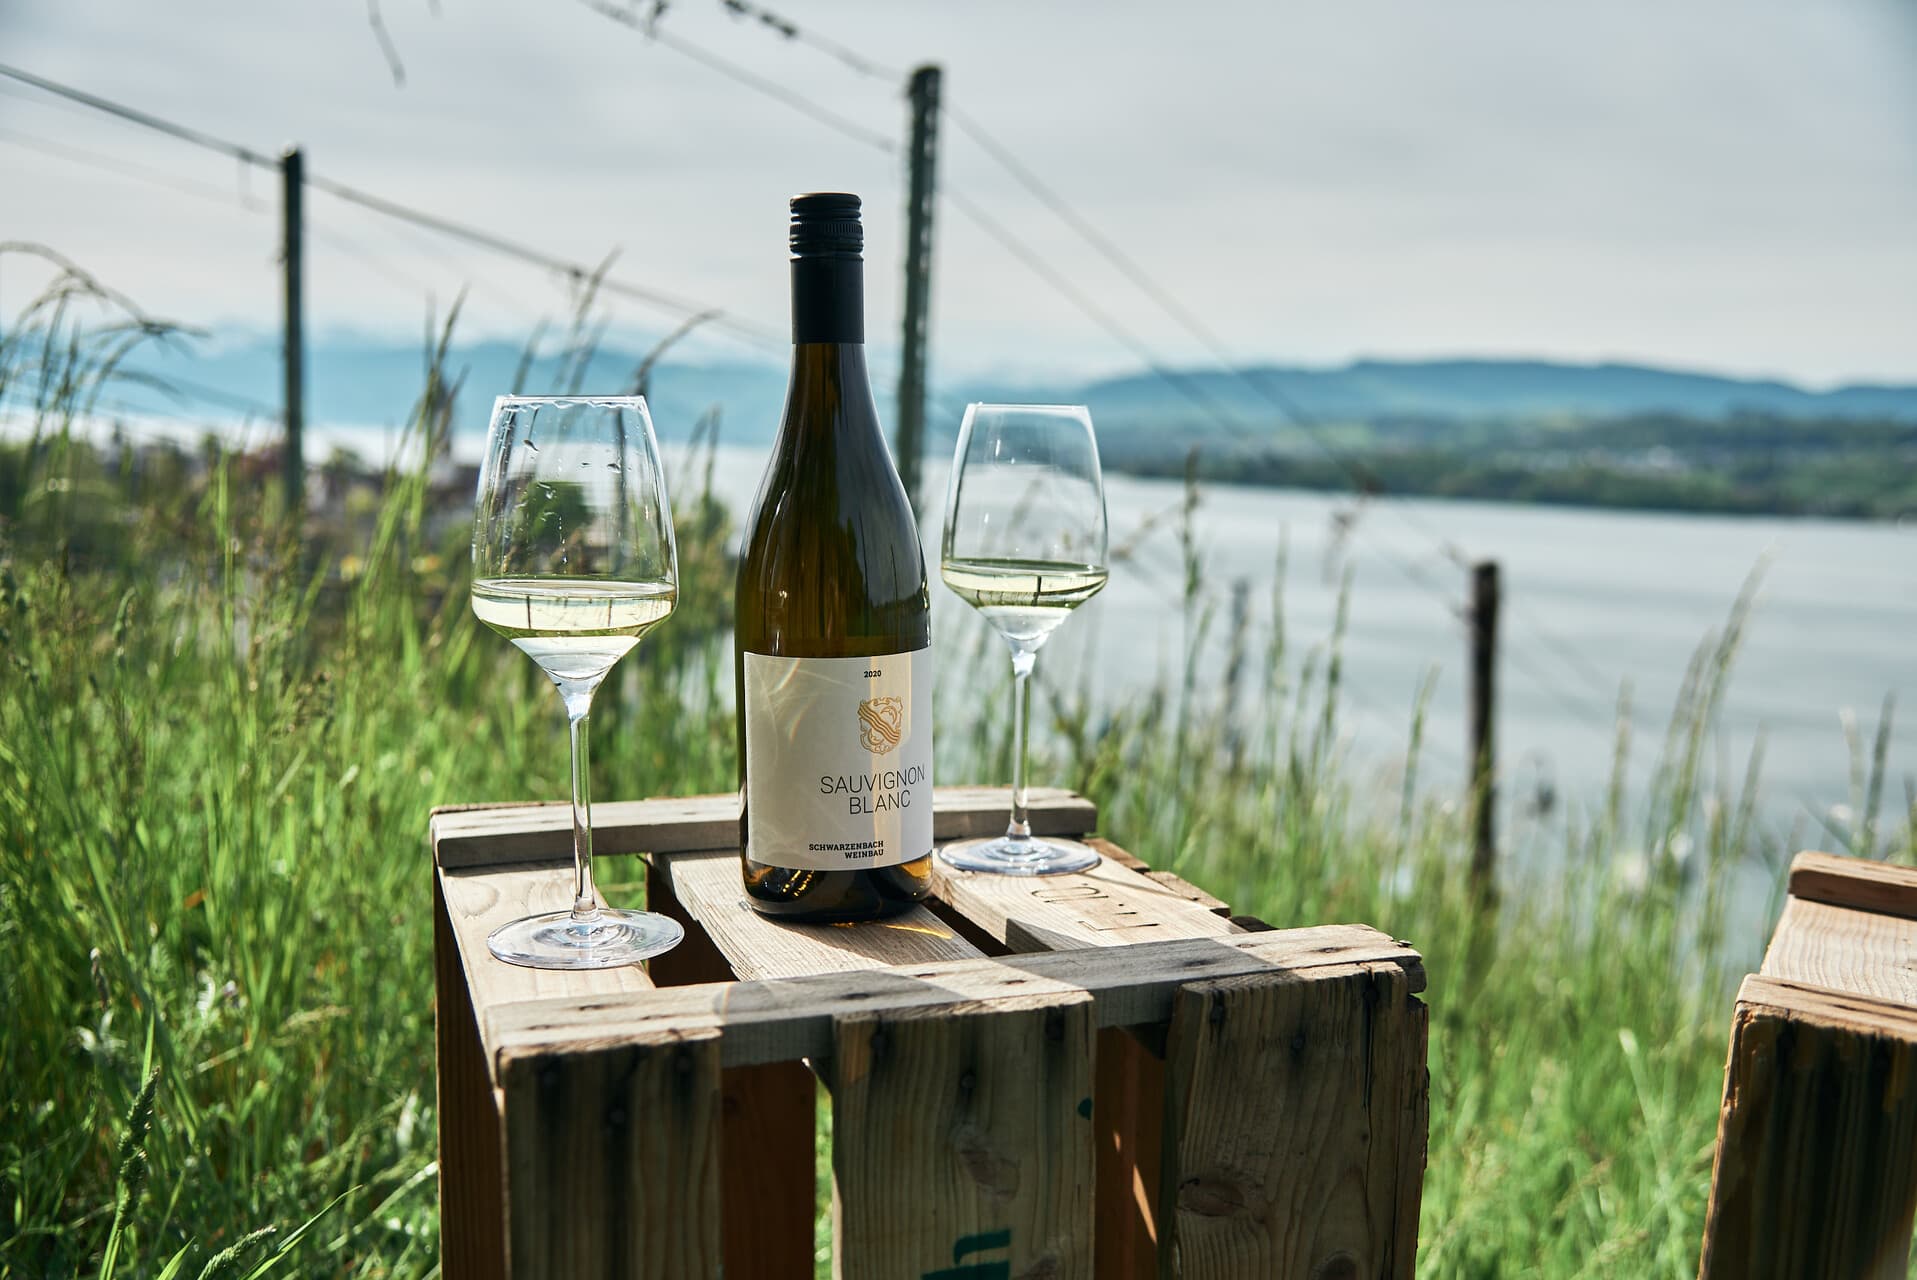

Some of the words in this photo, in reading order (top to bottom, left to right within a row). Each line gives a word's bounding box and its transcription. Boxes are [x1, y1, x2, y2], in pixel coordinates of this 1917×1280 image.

[864, 670, 882, 678] 2020
[820, 765, 925, 794] SAUVIGNON
[849, 790, 911, 815] BLANC
[808, 841, 884, 852] SCHWARZENBACH
[844, 849, 884, 859] WEINBAU
